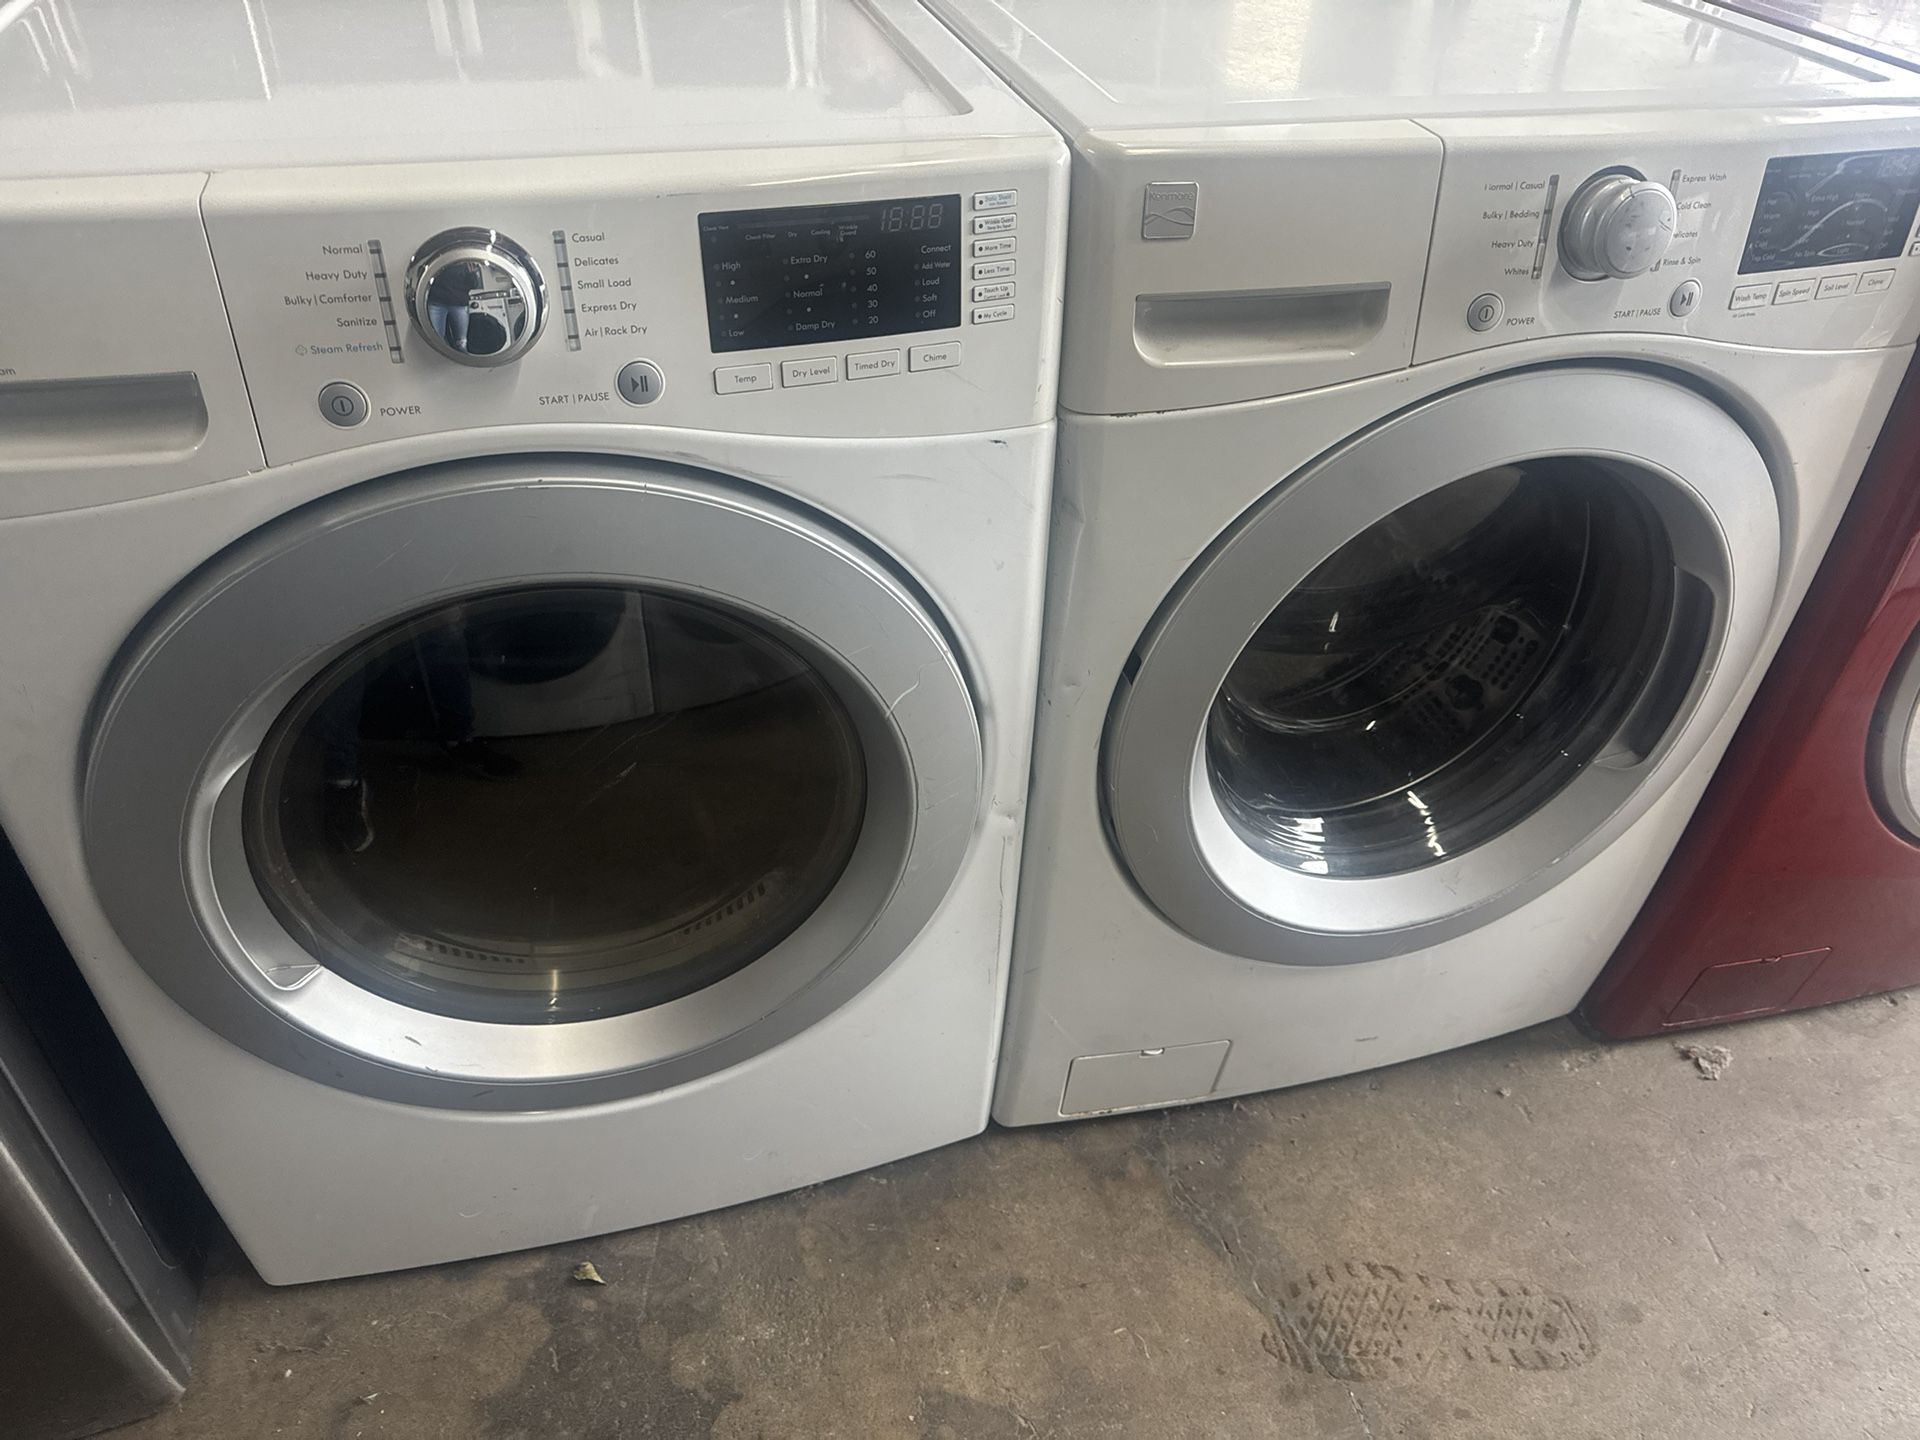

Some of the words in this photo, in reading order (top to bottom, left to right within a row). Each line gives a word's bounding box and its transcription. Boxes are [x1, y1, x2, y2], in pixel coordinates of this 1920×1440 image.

[1682, 174, 1707, 184] Express
[1709, 173, 1727, 181] Wash
[1520, 180, 1545, 190] Casual
[1677, 202, 1692, 210] Cold
[1693, 201, 1712, 210] Clean
[1482, 211, 1503, 220] Bulky
[1509, 209, 1540, 219] Bedding
[810, 228, 831, 236] Cooling
[1673, 231, 1698, 239] elicates
[571, 232, 605, 243] Casual
[921, 244, 952, 254] Connect
[1491, 240, 1515, 249] Heavy
[1517, 239, 1535, 248] Duty
[322, 244, 363, 255] Normal
[865, 250, 876, 259] 60
[574, 257, 619, 267] Delicates
[790, 256, 811, 265] Extra
[813, 254, 828, 264] Dry
[1663, 258, 1679, 266] Rinse
[1680, 257, 1686, 265] &
[1688, 256, 1702, 265] Spin
[722, 261, 741, 271] High
[866, 267, 877, 275] 50
[305, 271, 339, 281] Heavy
[343, 269, 368, 280] Duty
[1504, 267, 1529, 276] Whites
[577, 279, 605, 290] Small
[607, 277, 632, 288] Load
[922, 277, 940, 286] Loud
[1867, 278, 1884, 286] Chime
[867, 283, 878, 292] 40
[1778, 289, 1791, 298] Spin
[1792, 286, 1811, 296] Speed
[1823, 283, 1834, 292] Soil
[1834, 282, 1850, 291] Level
[793, 288, 823, 298] Normal
[923, 293, 937, 302] Soft
[1735, 293, 1751, 302] Wash
[1752, 293, 1768, 301] Temp
[725, 295, 758, 303] Medium
[867, 299, 878, 308] 30
[581, 303, 617, 314] Express
[620, 301, 637, 311] Dry
[923, 309, 936, 318] Off
[1613, 310, 1635, 319] START
[1639, 308, 1662, 317] PAUSE
[336, 317, 377, 327] Sanitize
[869, 315, 879, 324] 20
[1506, 317, 1536, 326] POWER
[631, 325, 648, 335] Dry
[796, 322, 820, 331] Damp
[822, 320, 835, 329] Dry
[310, 345, 343, 355] Steam
[345, 342, 383, 353] Refresh
[923, 353, 948, 362] Chime
[854, 361, 879, 370] Timed
[881, 359, 896, 369] Dry
[792, 368, 809, 378] Dry
[810, 366, 831, 376] Level
[734, 374, 757, 384] Temp
[539, 394, 569, 405] START
[578, 392, 610, 403] PAUSE
[380, 406, 421, 416] POWER
